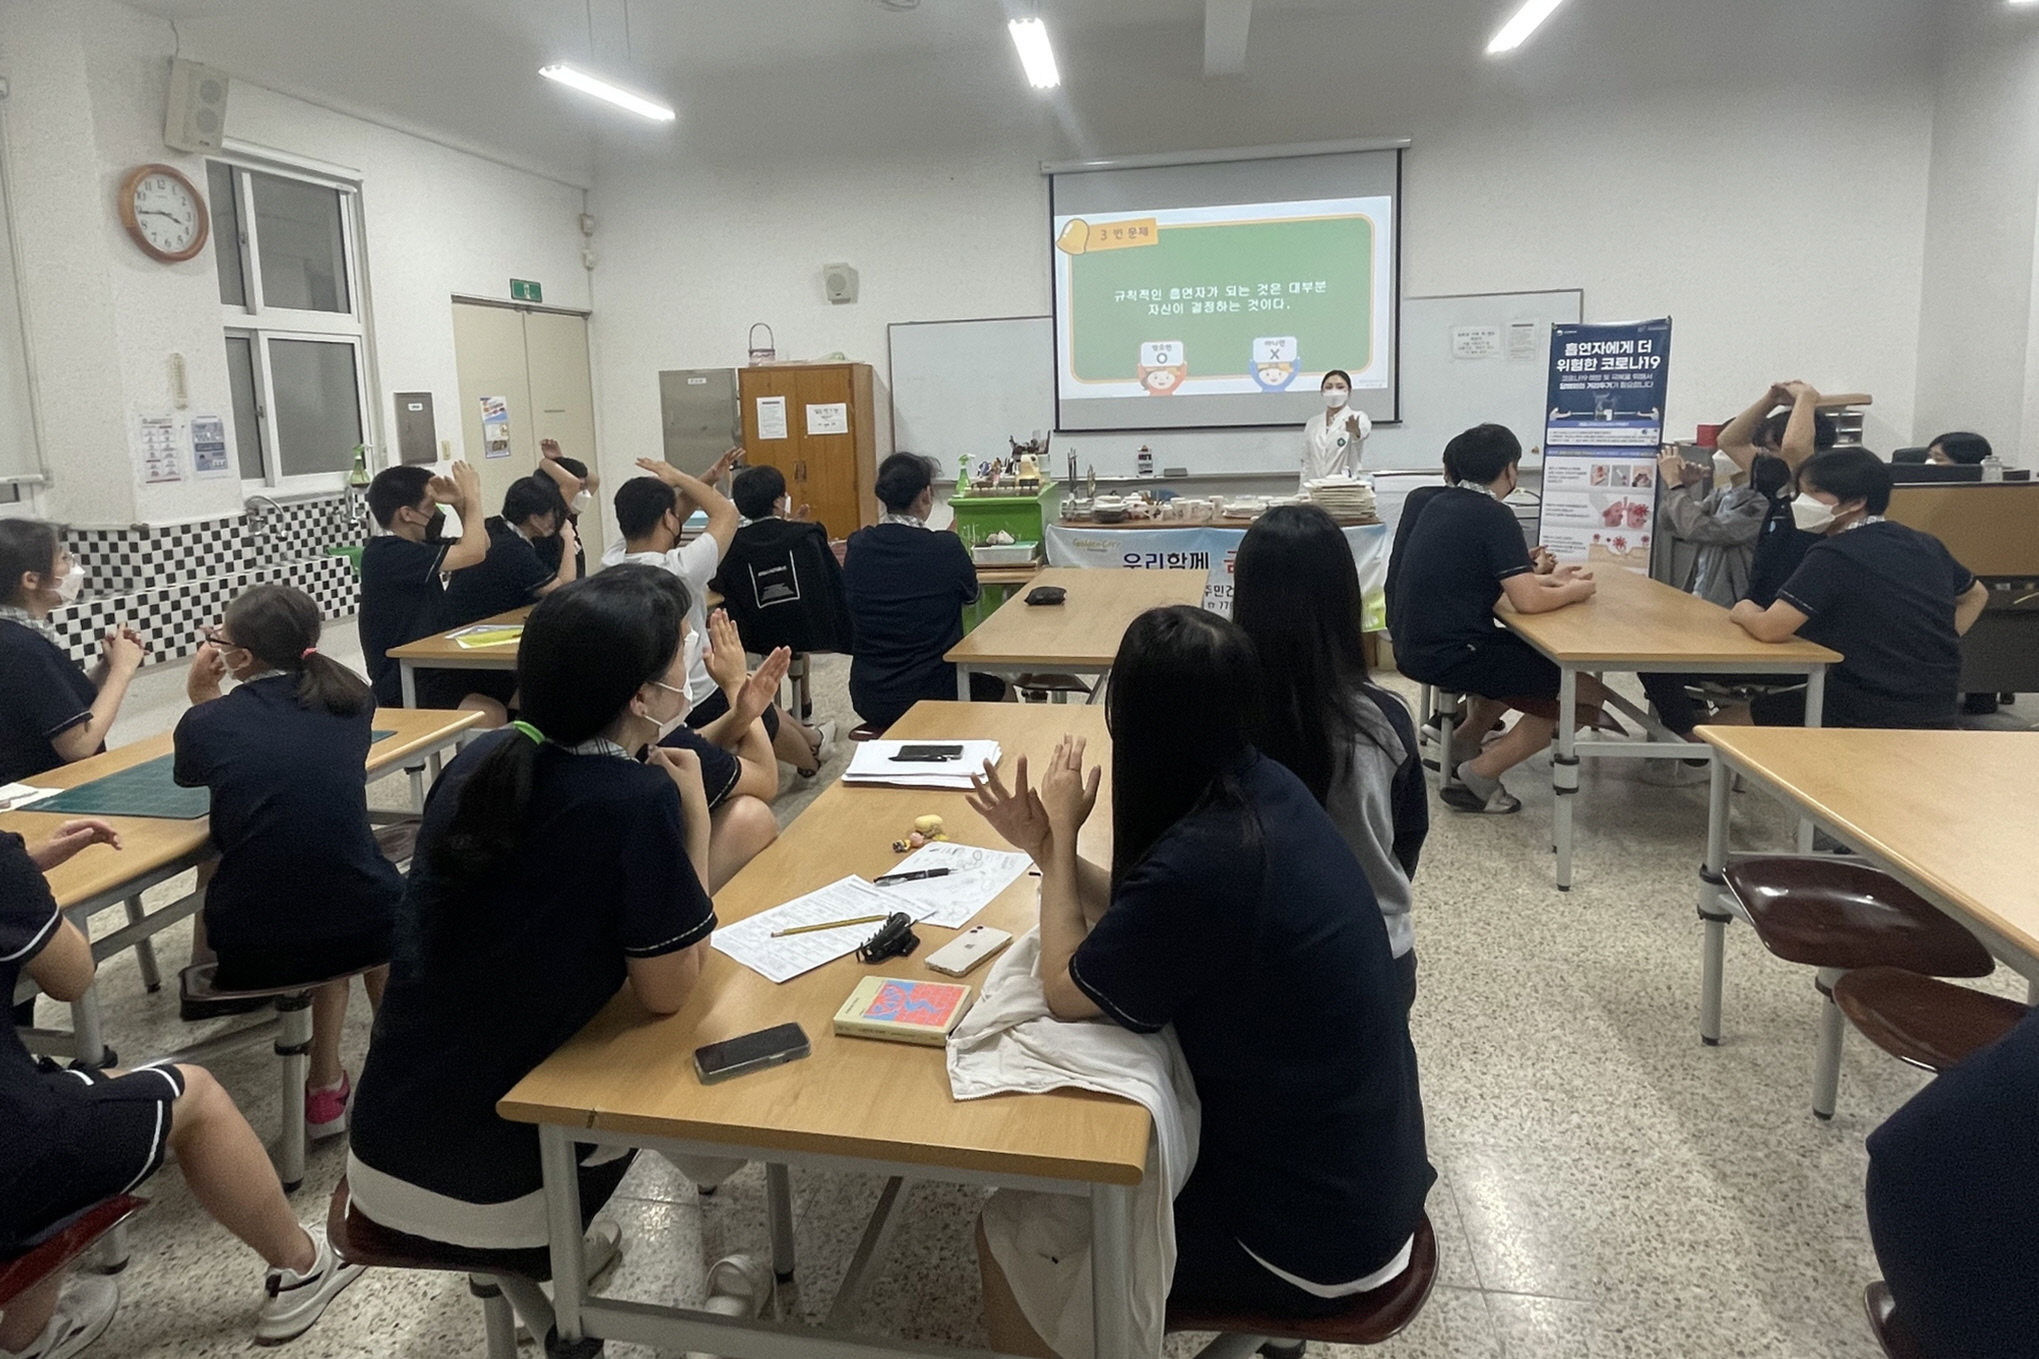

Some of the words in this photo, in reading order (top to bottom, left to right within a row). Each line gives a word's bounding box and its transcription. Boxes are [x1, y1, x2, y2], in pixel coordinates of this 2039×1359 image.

[144, 181, 152, 191] 11
[157, 179, 166, 190] 12
[172, 184, 178, 196] 1
[137, 191, 147, 201] 10
[181, 196, 187, 207] 2
[186, 211, 192, 223] 3
[140, 219, 148, 230] 8
[151, 232, 158, 242] 7
[1100, 229, 1108, 241] 3
[1128, 226, 1149, 239] 문제
[164, 238, 172, 248] 6
[1114, 288, 1162, 302] 규칙적인
[1170, 286, 1218, 300] 흡연자가
[1226, 284, 1250, 297] 되는
[1257, 282, 1282, 296] 것은
[1288, 280, 1327, 294] 대부분
[1148, 302, 1184, 316] 자신이
[1191, 300, 1241, 314] 결정하는
[1248, 298, 1290, 312] 것이다.
[1565, 340, 1634, 356] 흡연자에게
[1637, 339, 1652, 354] 더
[1556, 357, 1598, 372] 위험한
[1600, 355, 1661, 370] 코로나19
[1122, 552, 1209, 570] 우리함께
